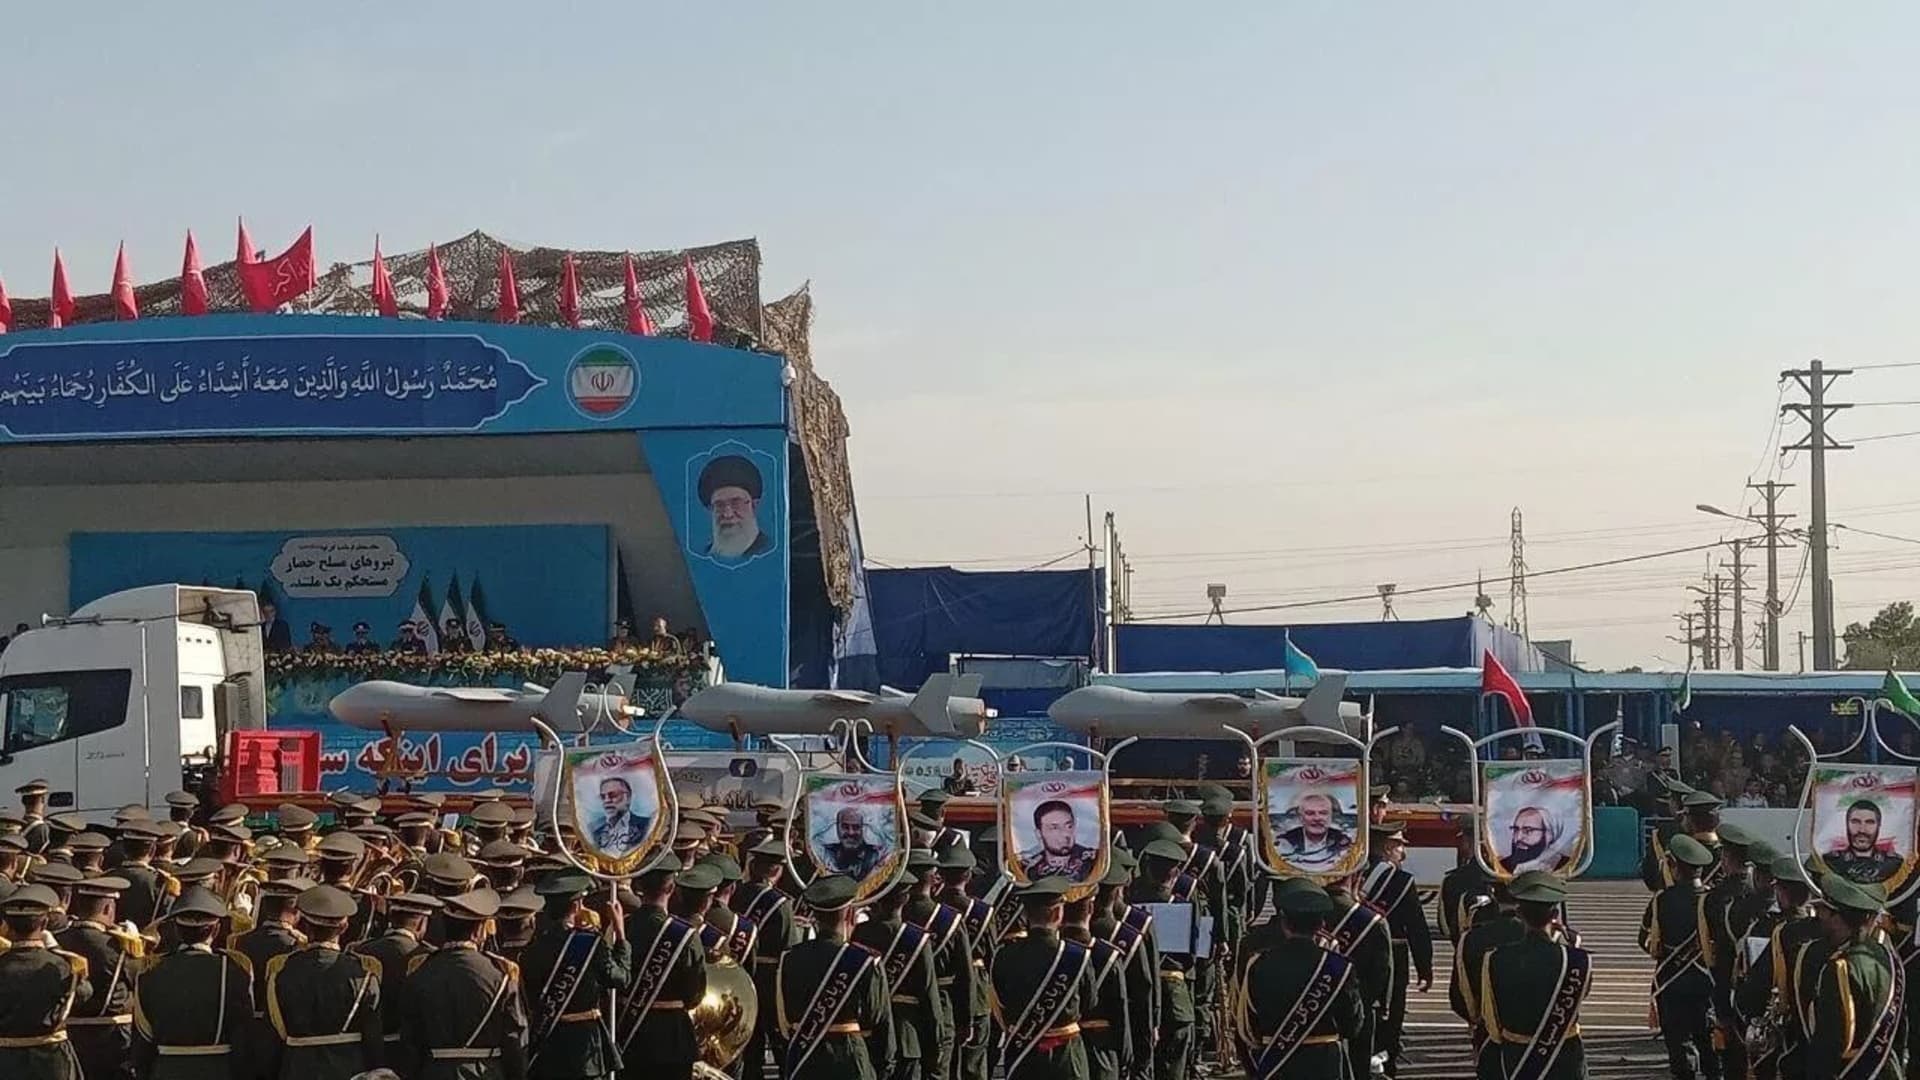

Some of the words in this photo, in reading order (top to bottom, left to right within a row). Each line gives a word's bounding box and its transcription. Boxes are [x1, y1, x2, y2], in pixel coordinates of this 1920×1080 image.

[285, 557, 316, 573] حصار
[319, 555, 347, 571] مسلح
[447, 732, 531, 786] برای
